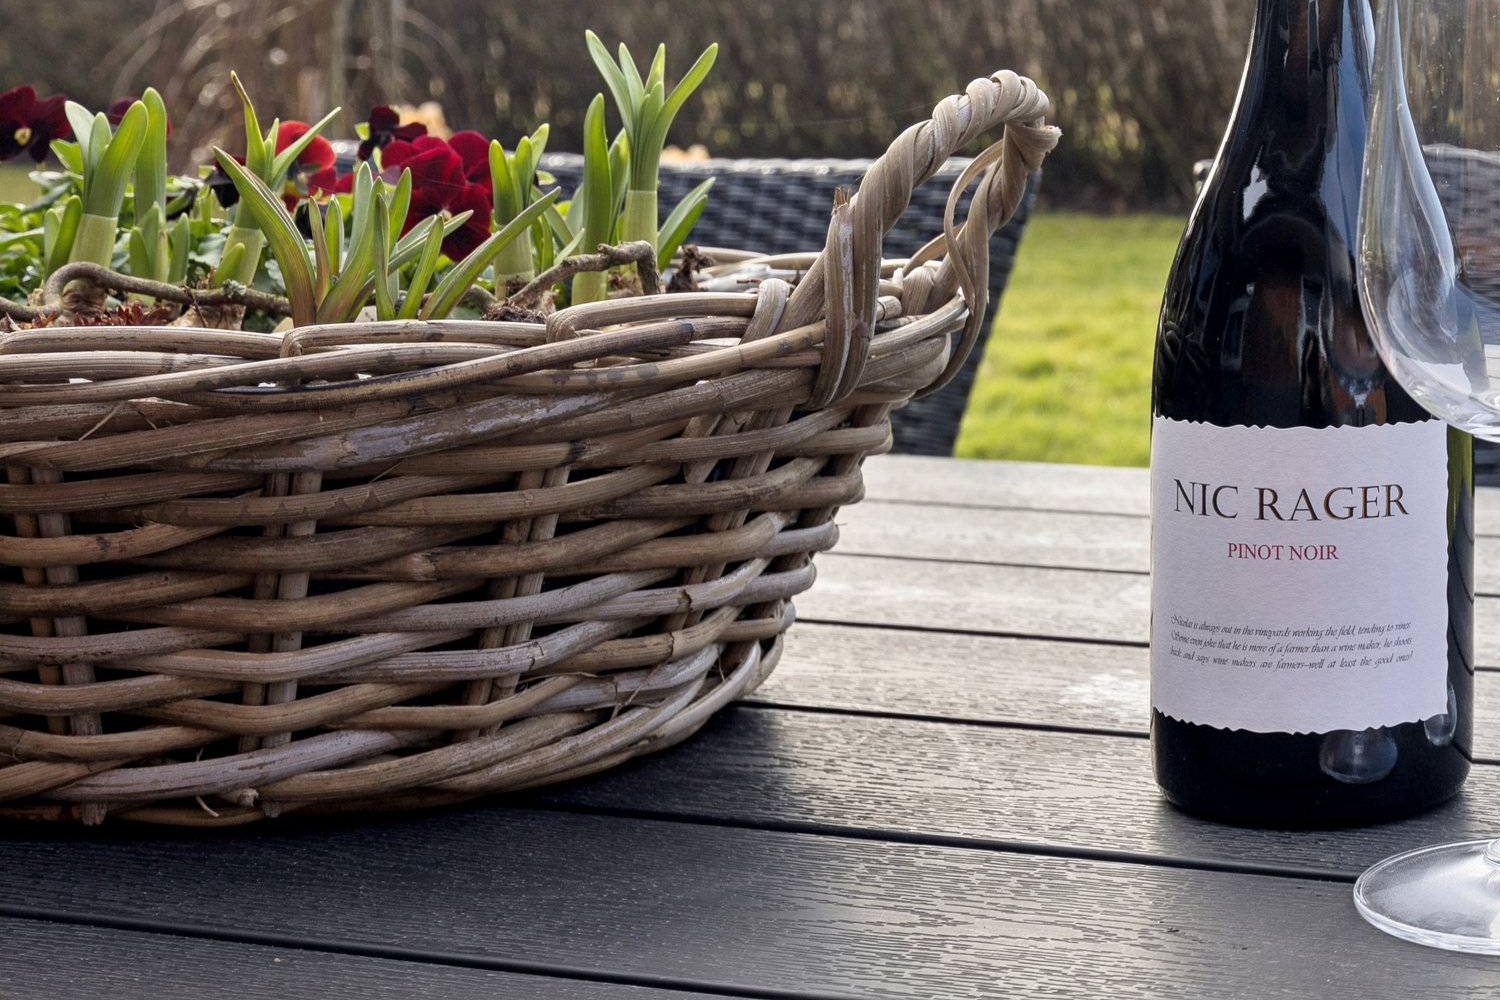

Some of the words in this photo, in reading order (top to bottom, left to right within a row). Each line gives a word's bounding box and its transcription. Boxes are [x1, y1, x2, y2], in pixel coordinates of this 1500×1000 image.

[1173, 478, 1239, 519] NIC
[1254, 483, 1410, 522] RAGER
[1227, 542, 1285, 561] PINOT
[1289, 543, 1339, 561] NOIR
[1199, 621, 1221, 635] always
[1221, 626, 1233, 634] out
[1233, 626, 1241, 635] in
[1242, 625, 1254, 635] the
[1255, 627, 1291, 640] vineyards
[1292, 627, 1324, 641] working
[1325, 625, 1338, 637] the
[1358, 623, 1386, 637] tending
[1386, 624, 1394, 632] to
[1200, 638, 1217, 650] joke
[1217, 639, 1231, 649] that
[1232, 640, 1241, 651] he
[1242, 642, 1248, 651] is
[1249, 644, 1267, 652] more
[1268, 642, 1280, 656] of
[1281, 643, 1311, 657] farmer
[1311, 643, 1330, 653] than
[1338, 643, 1357, 652] wine
[1383, 638, 1393, 648] he
[1183, 651, 1195, 660] and
[1196, 655, 1210, 665] says
[1213, 657, 1229, 665] wine
[1232, 657, 1257, 668] makers
[1260, 661, 1273, 669] are
[1327, 660, 1337, 669] at
[1340, 657, 1357, 668] least
[1360, 656, 1372, 667] the
[1373, 653, 1394, 669] good
